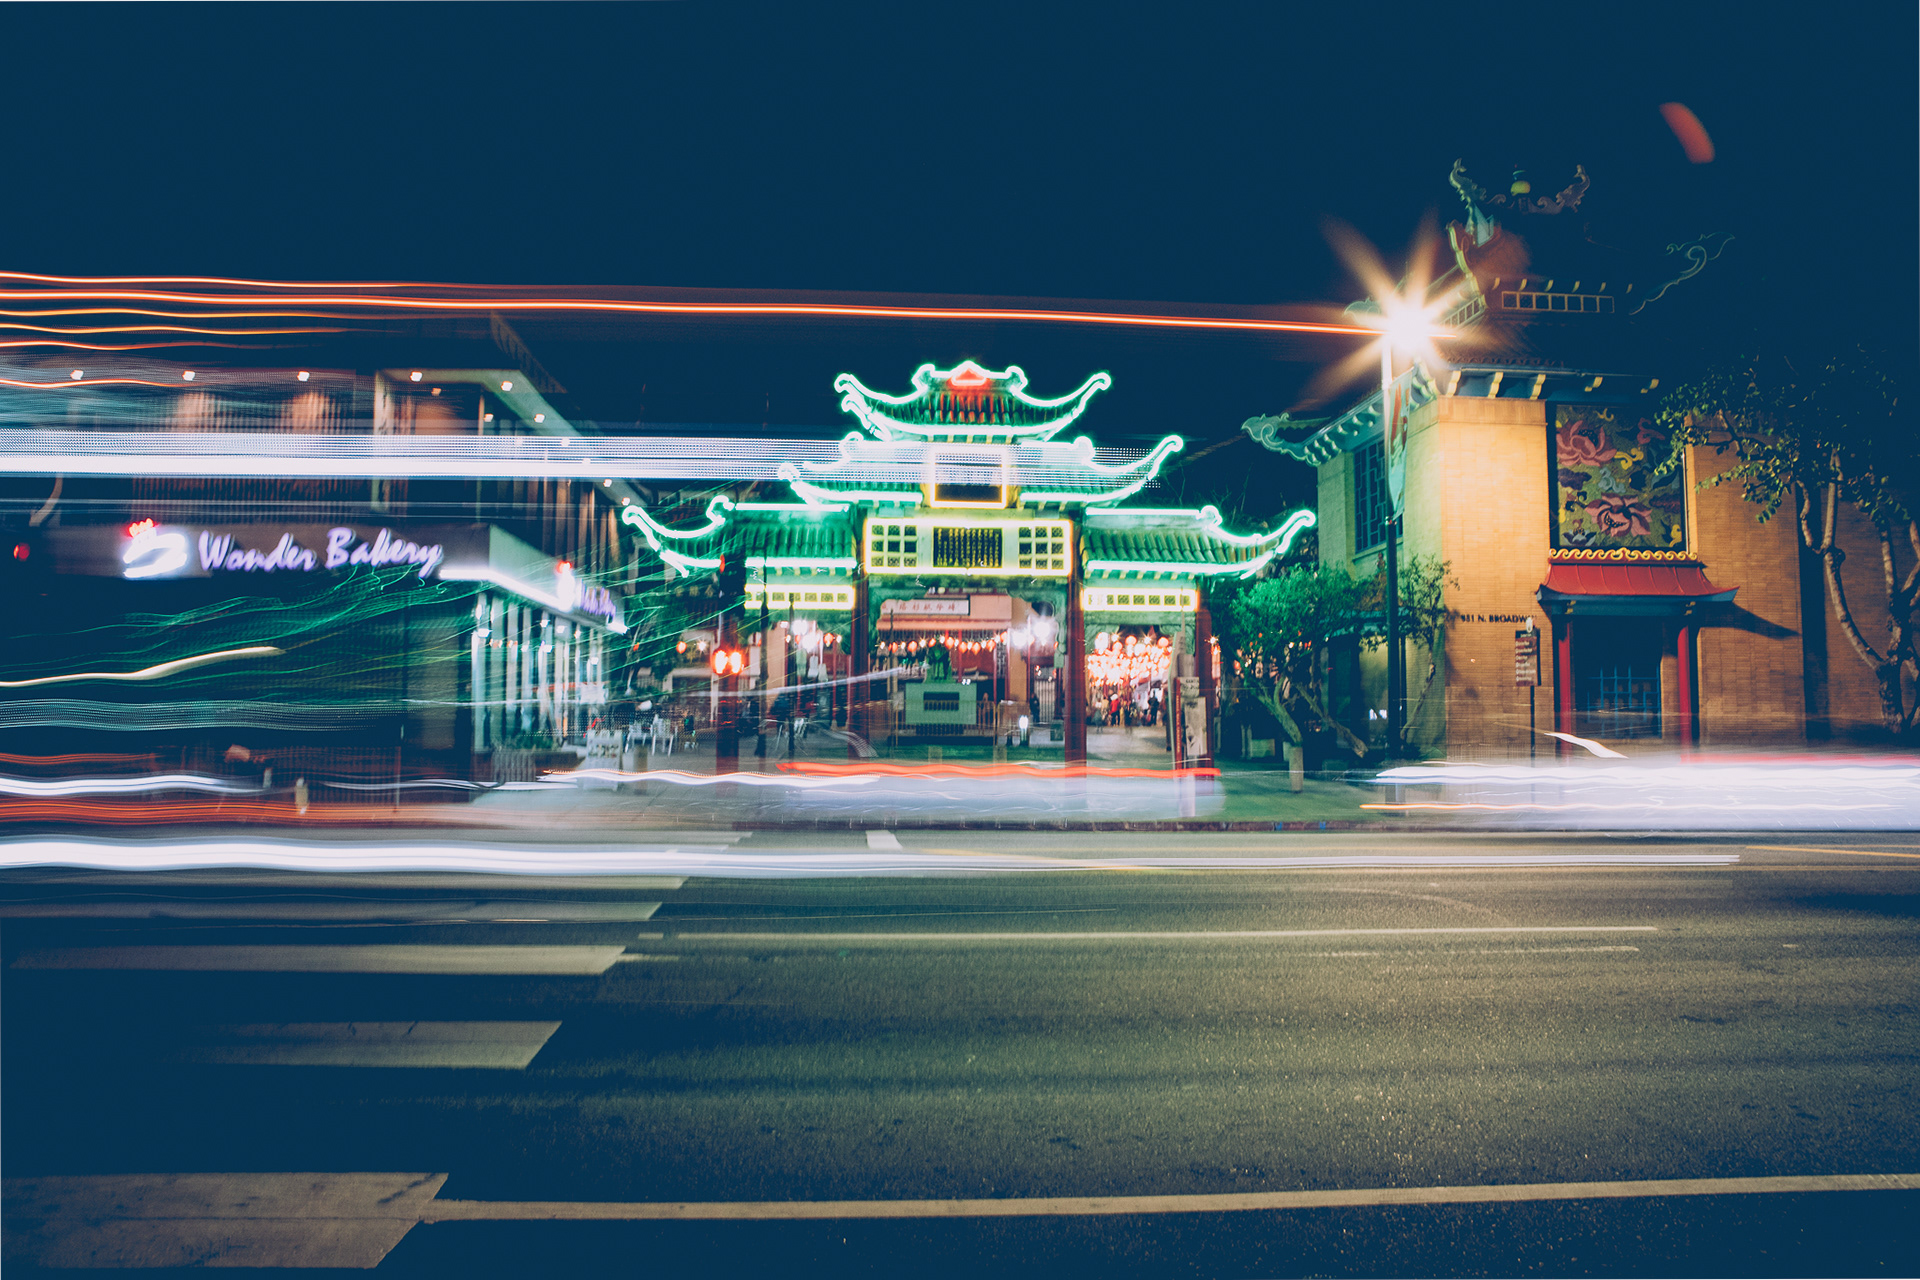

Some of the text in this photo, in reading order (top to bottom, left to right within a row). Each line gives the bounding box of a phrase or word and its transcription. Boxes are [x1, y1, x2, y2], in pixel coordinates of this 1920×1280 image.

[199, 527, 443, 579] Wonder Bakery
[1489, 614, 1537, 623] BROADW
